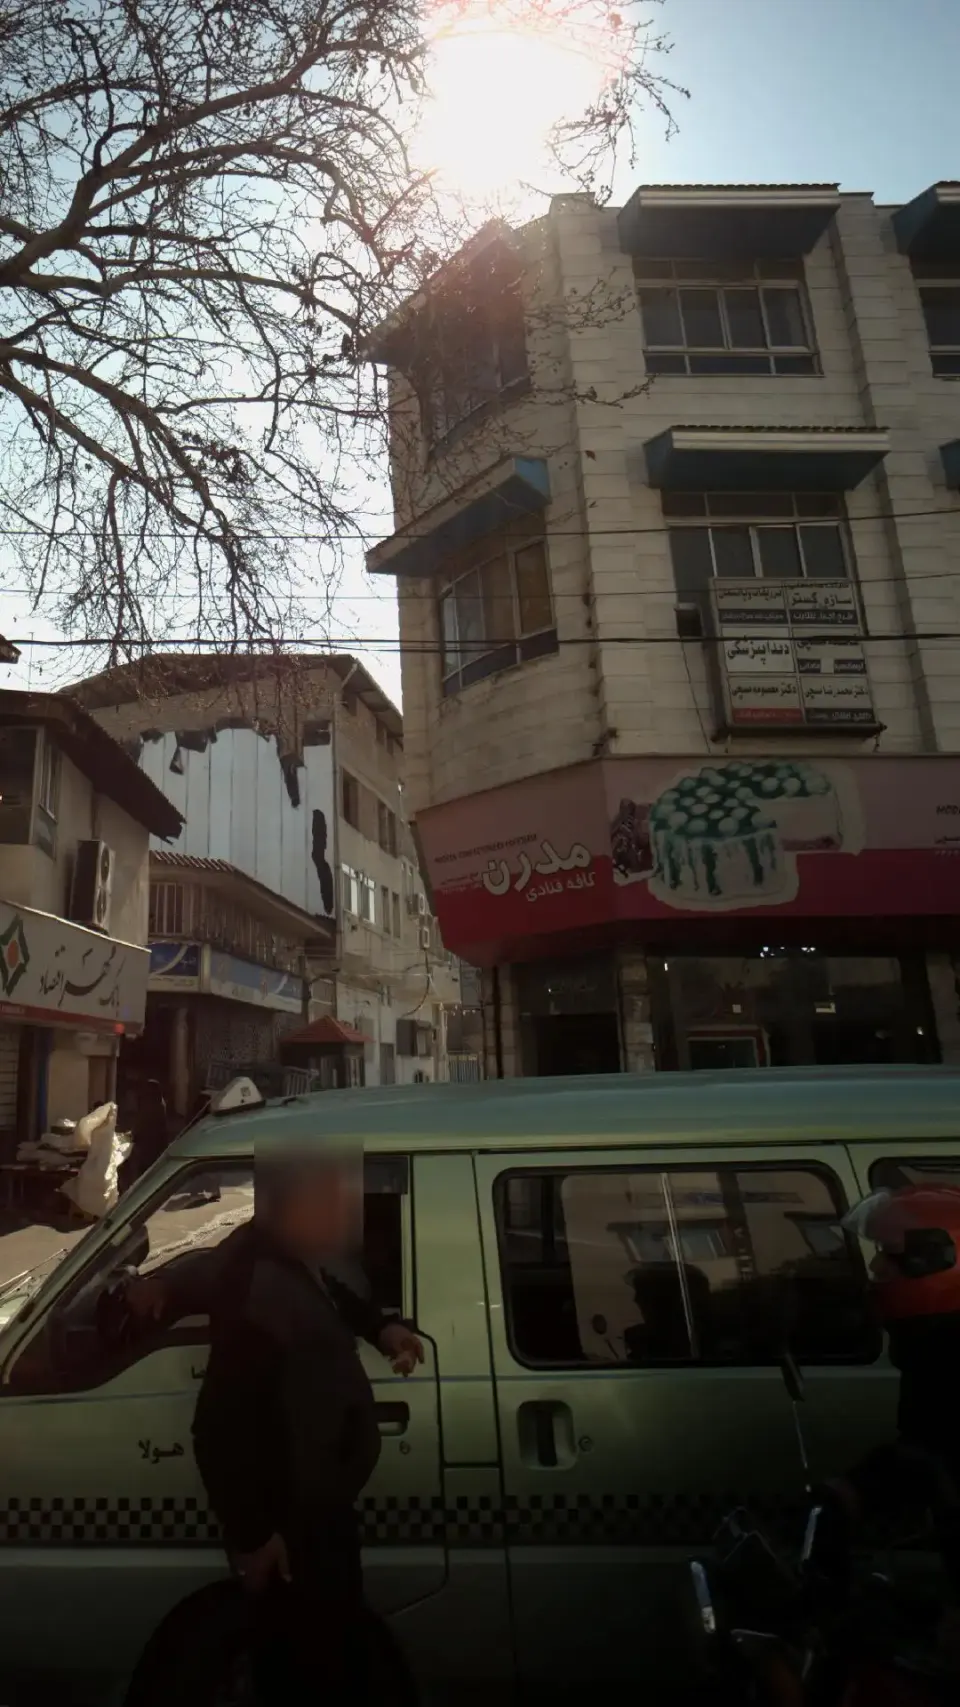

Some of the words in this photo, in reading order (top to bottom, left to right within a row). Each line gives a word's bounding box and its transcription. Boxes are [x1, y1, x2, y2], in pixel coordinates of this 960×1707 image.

[482, 839, 591, 896] مدرن
[524, 880, 564, 903] قنادی
[566, 870, 597, 890] کافه
